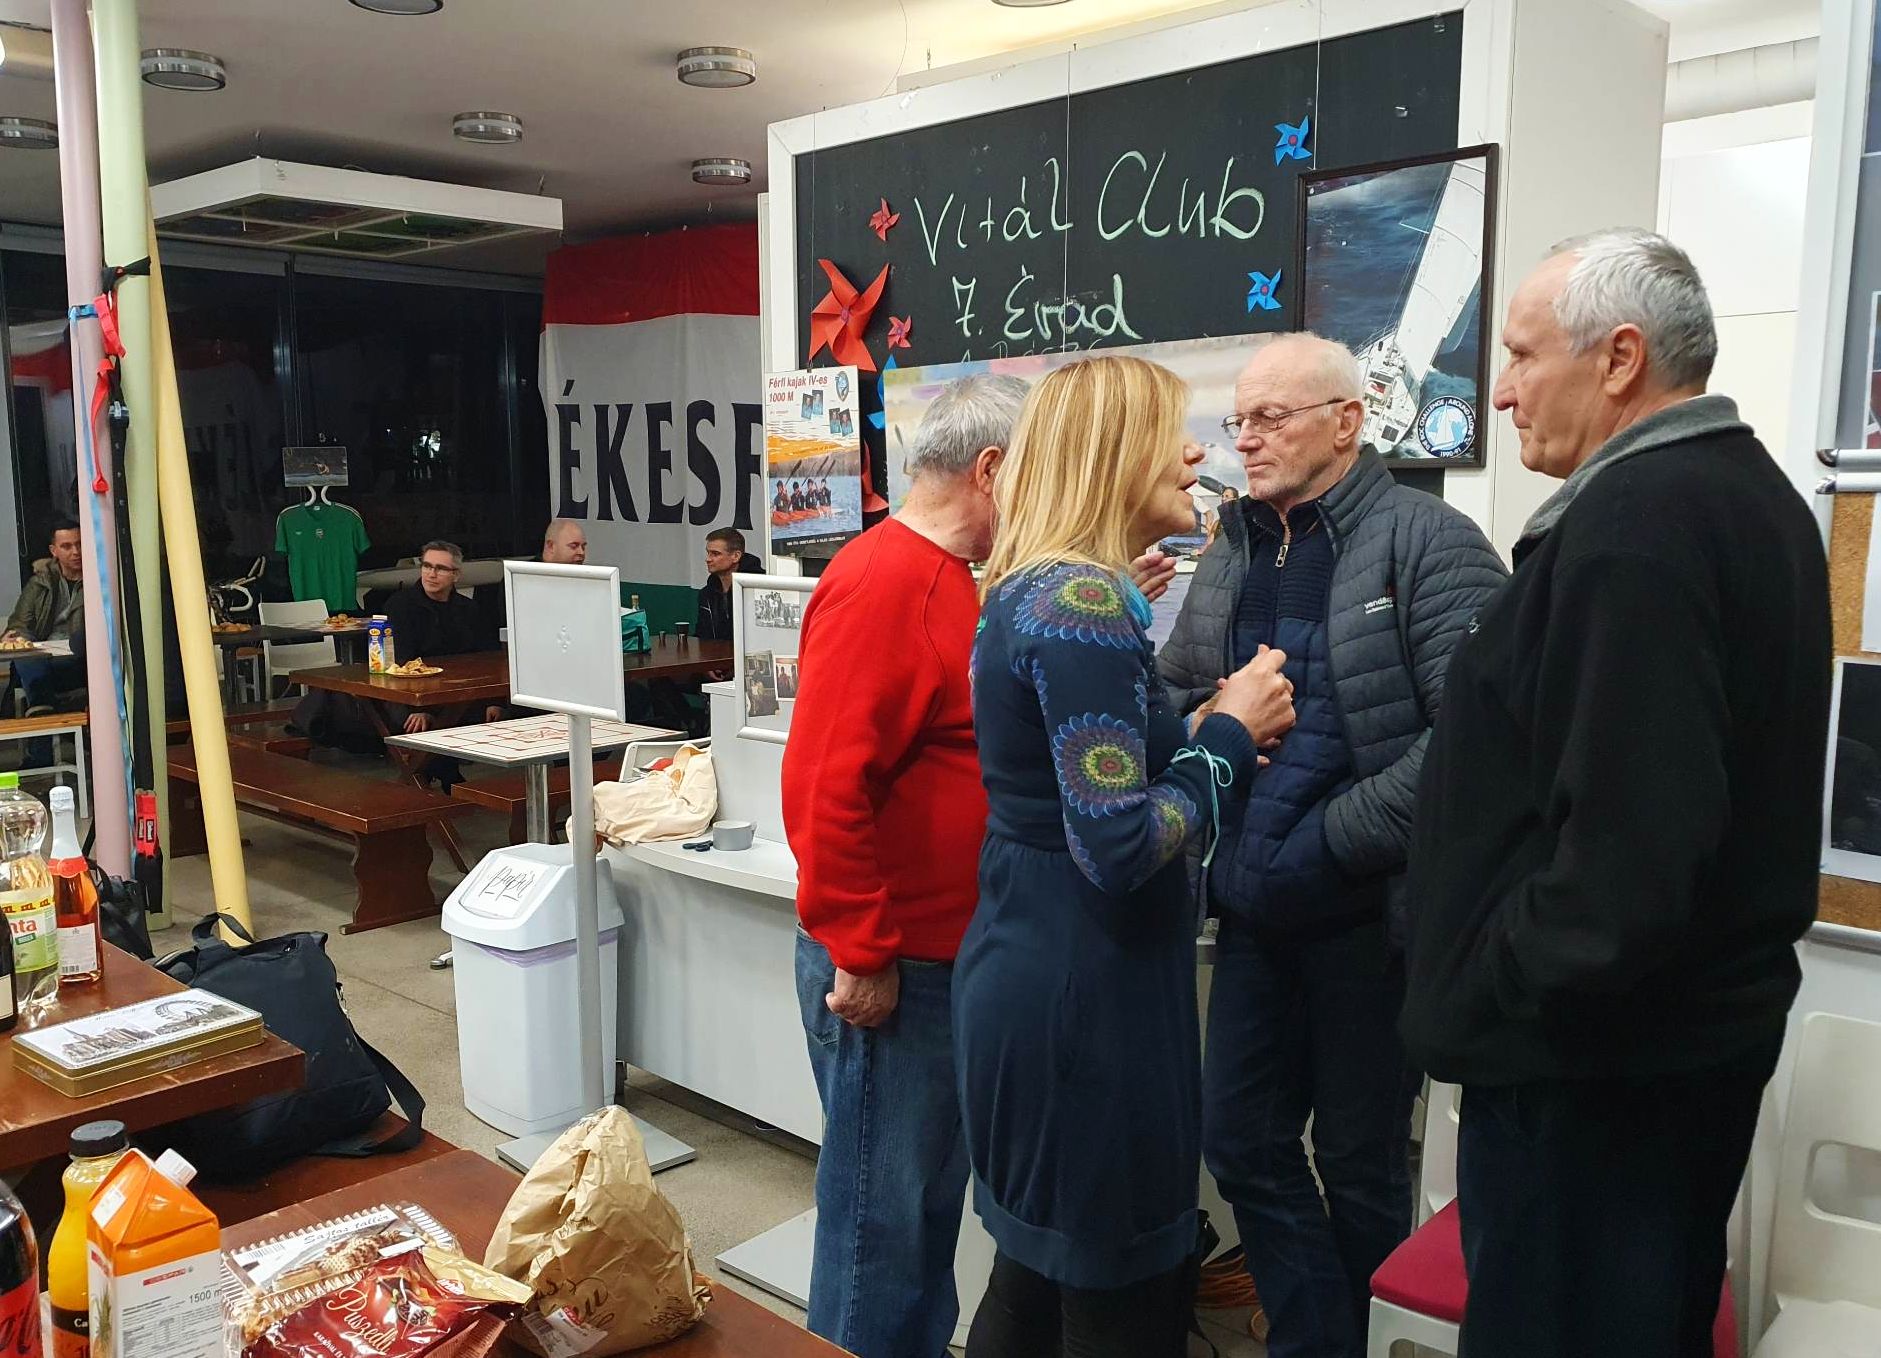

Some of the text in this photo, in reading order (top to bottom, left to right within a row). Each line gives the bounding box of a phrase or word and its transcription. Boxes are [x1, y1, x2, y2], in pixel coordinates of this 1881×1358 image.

[914, 150, 1265, 266] Vitál Club
[952, 276, 984, 338] 7.
[769, 376, 786, 389] Férfi
[787, 375, 806, 389] kajak
[769, 391, 793, 402] 1000 M
[189, 1289, 212, 1304] 1500
[73, 1317, 88, 1328] Ca
[326, 1285, 399, 1353] Puszedli
